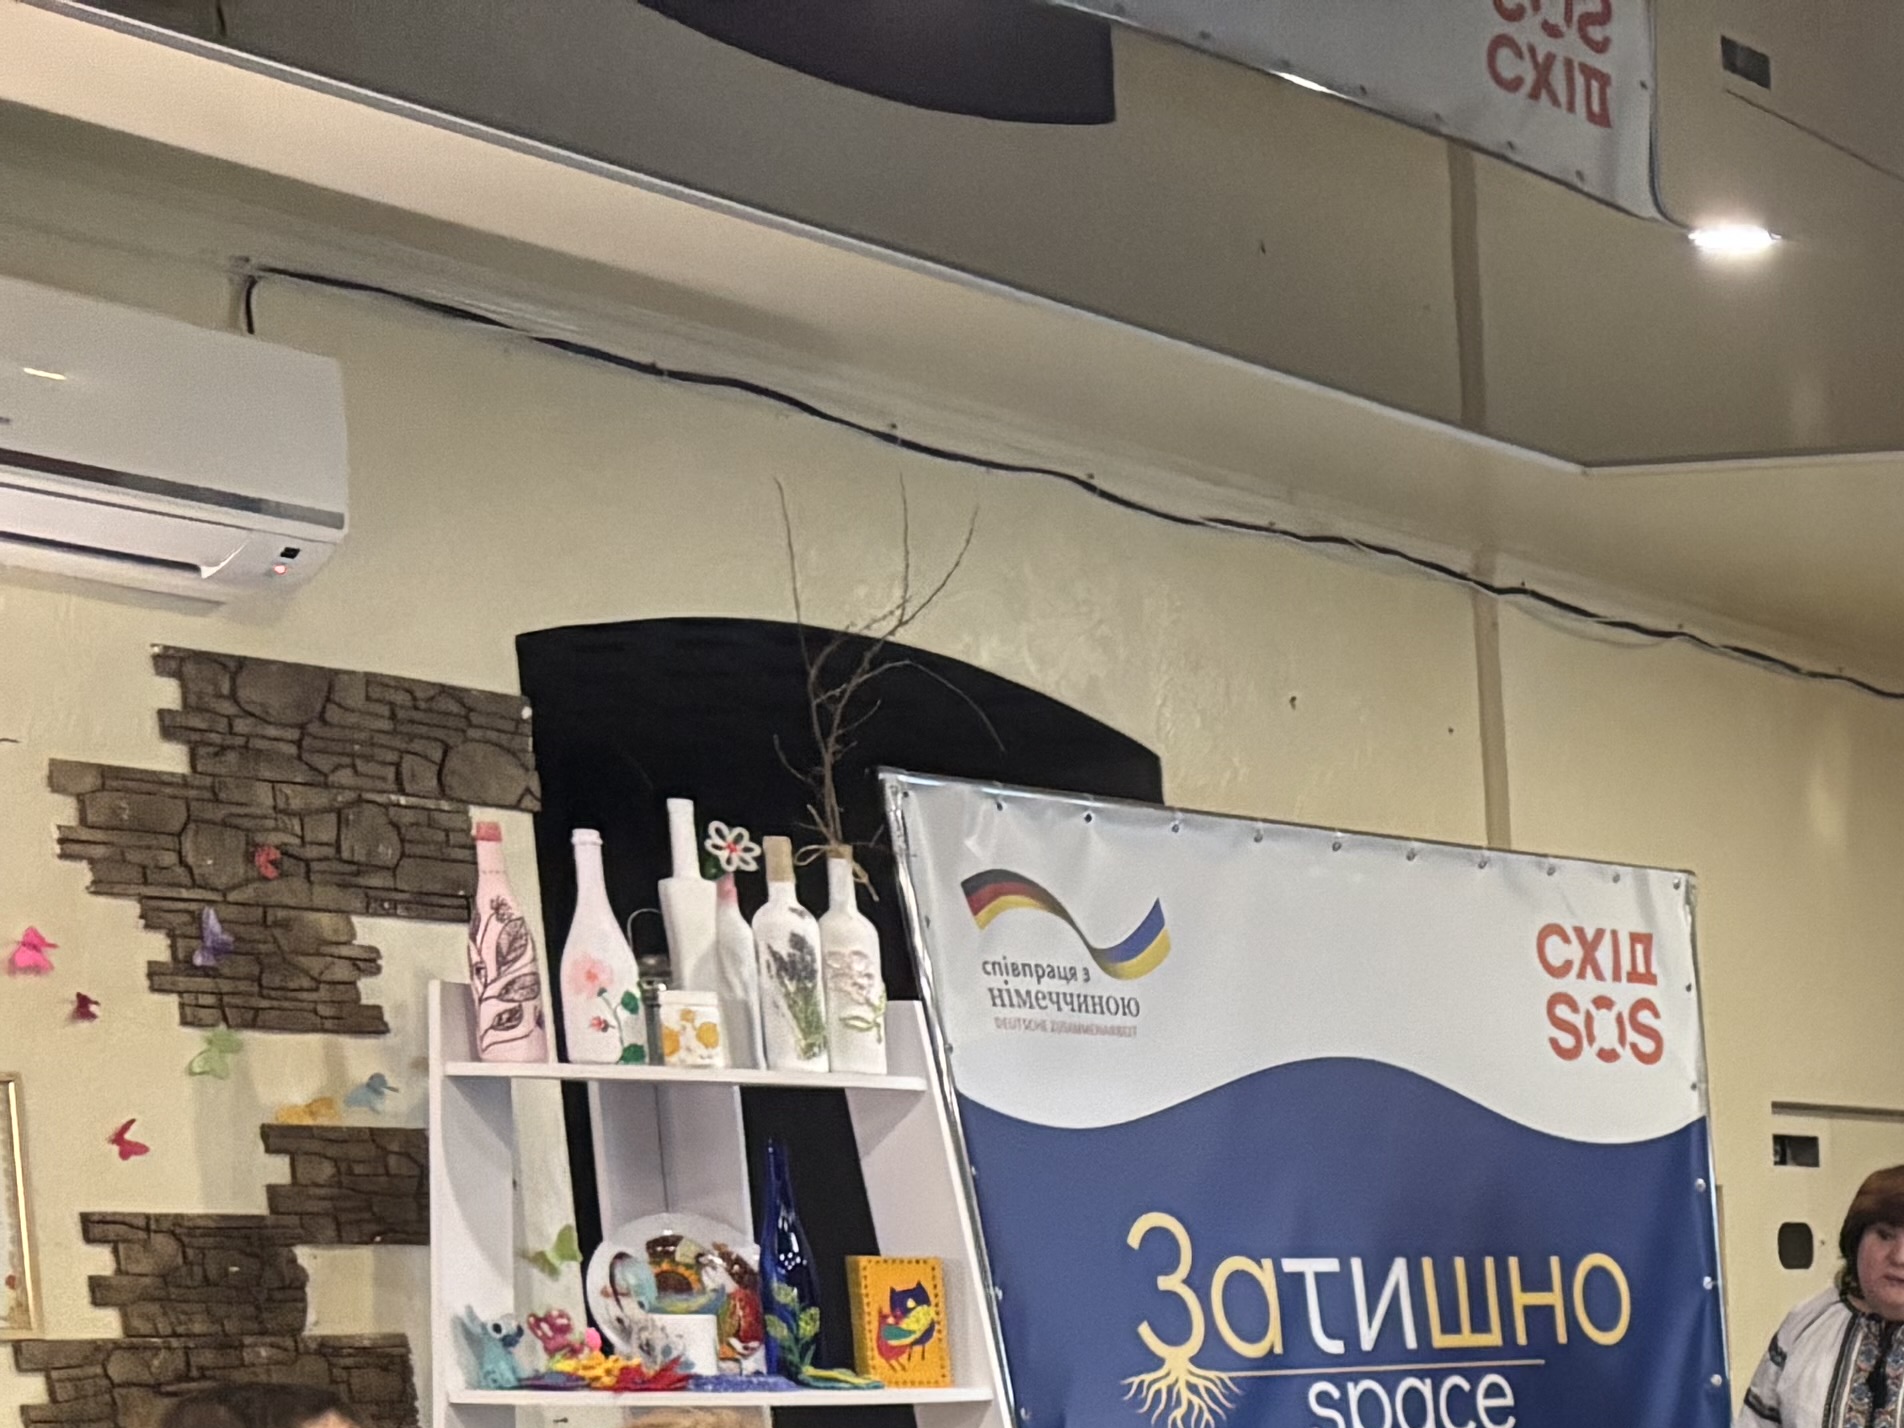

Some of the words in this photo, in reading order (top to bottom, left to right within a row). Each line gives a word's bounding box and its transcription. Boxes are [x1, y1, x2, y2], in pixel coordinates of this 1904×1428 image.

[981, 955, 1078, 985] співпраця
[1082, 966, 1091, 983] з
[1536, 921, 1659, 987] СХІД
[1545, 991, 1665, 1066] SOS
[1126, 1210, 1632, 1362] Затишно
